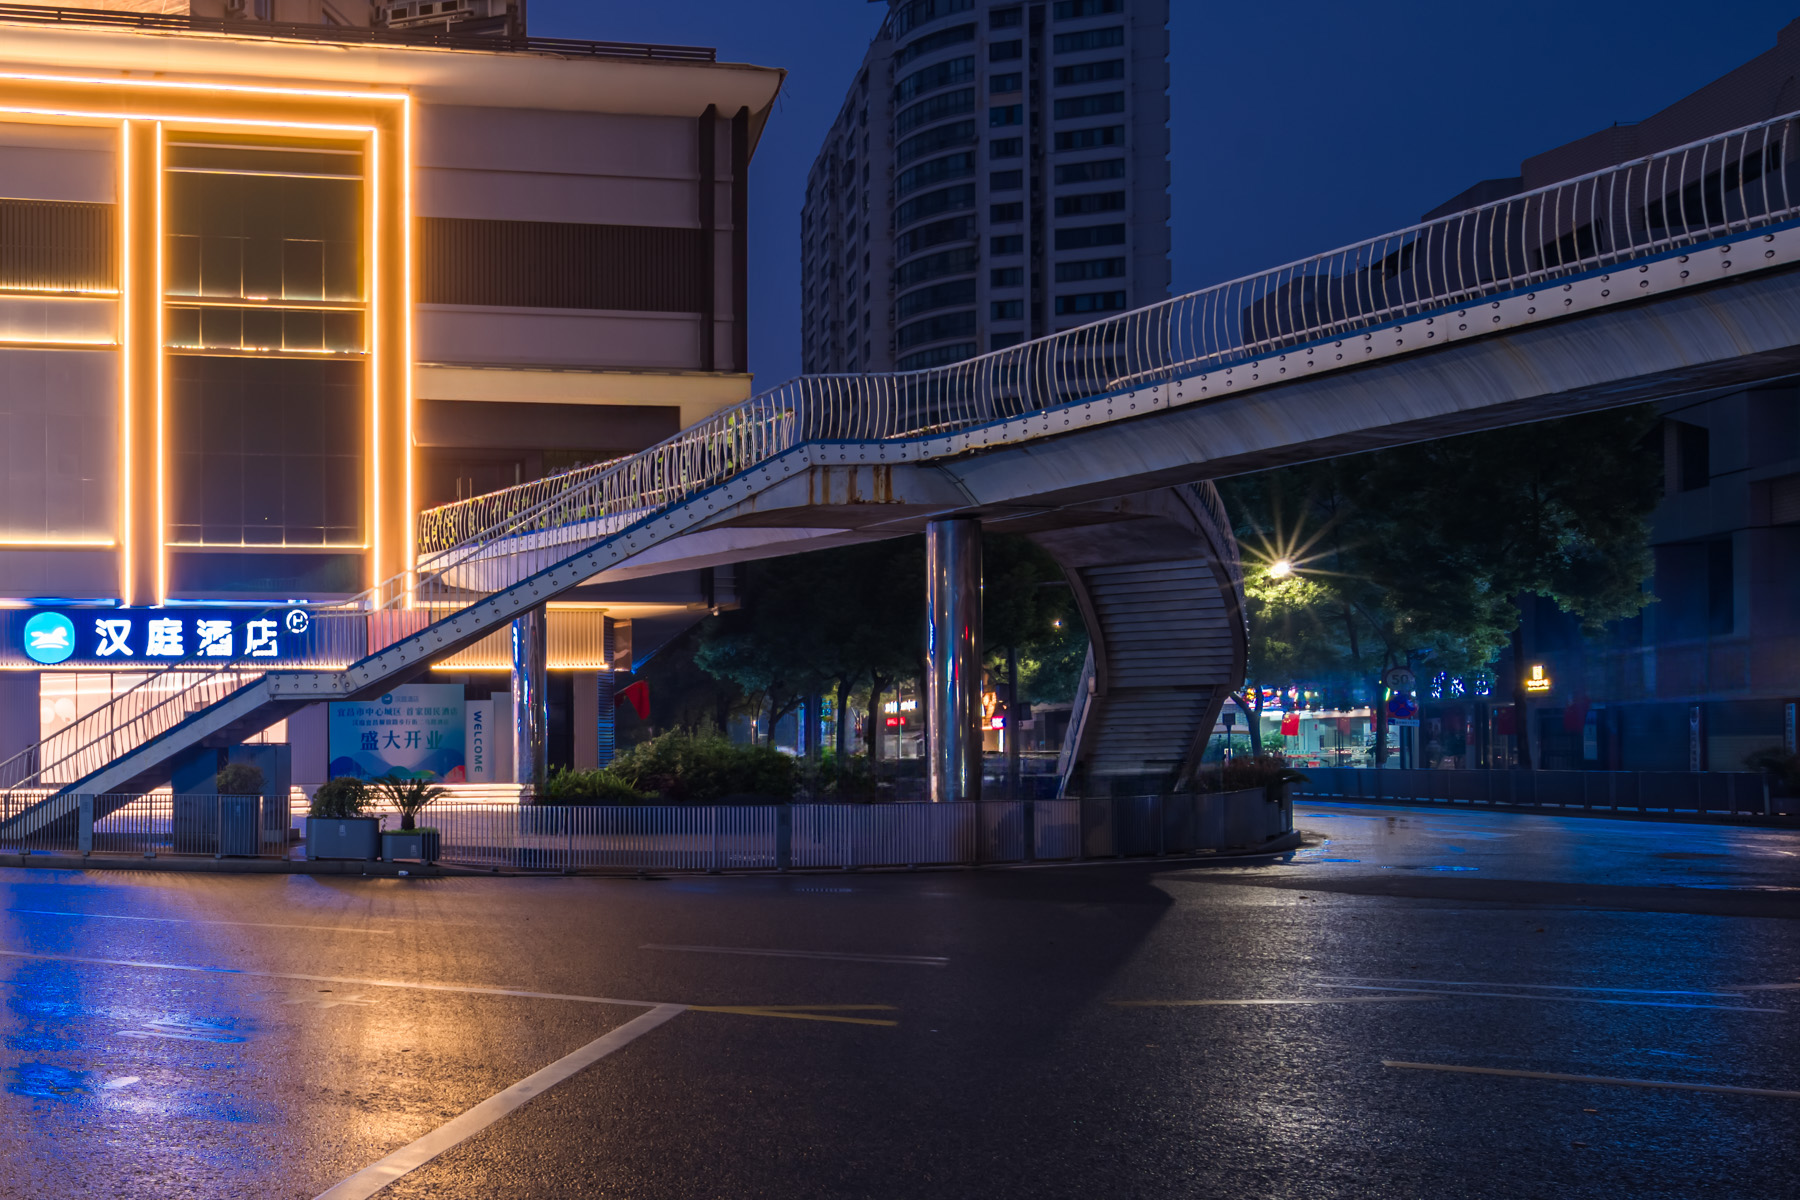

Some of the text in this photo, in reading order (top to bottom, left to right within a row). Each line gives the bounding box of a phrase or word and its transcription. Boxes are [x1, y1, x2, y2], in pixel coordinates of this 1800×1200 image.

[94, 617, 278, 657] 汉庭酒店
[1392, 674, 1409, 685] 50
[360, 730, 443, 751] 盛大开业
[473, 710, 483, 773] WELCOME
